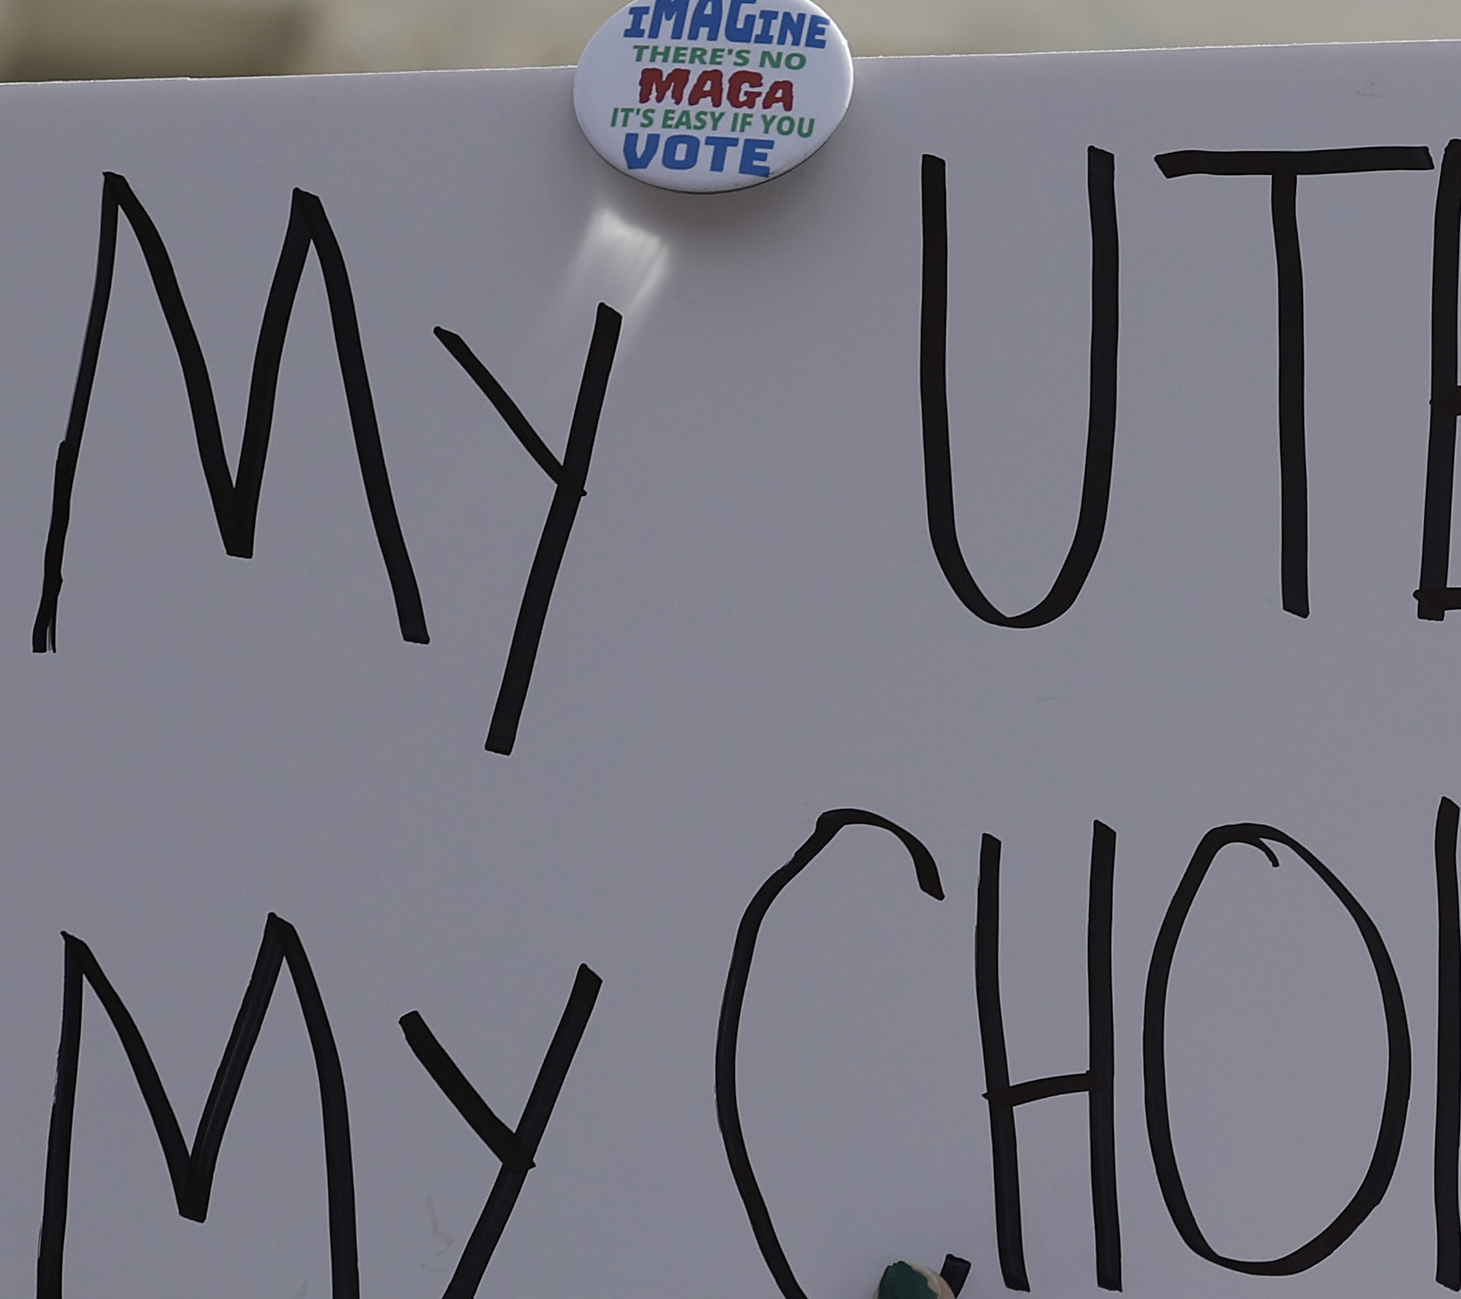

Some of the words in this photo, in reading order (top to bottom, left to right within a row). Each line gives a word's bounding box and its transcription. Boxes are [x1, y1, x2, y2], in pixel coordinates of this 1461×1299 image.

[633, 44, 751, 67] THERE'S
[759, 50, 807, 70] NO
[638, 67, 795, 112] MAGA
[610, 107, 655, 128] IT'S
[661, 108, 725, 132] EASY
[730, 113, 754, 133] IF
[761, 114, 816, 139] YOU
[622, 132, 775, 178] VOTE
